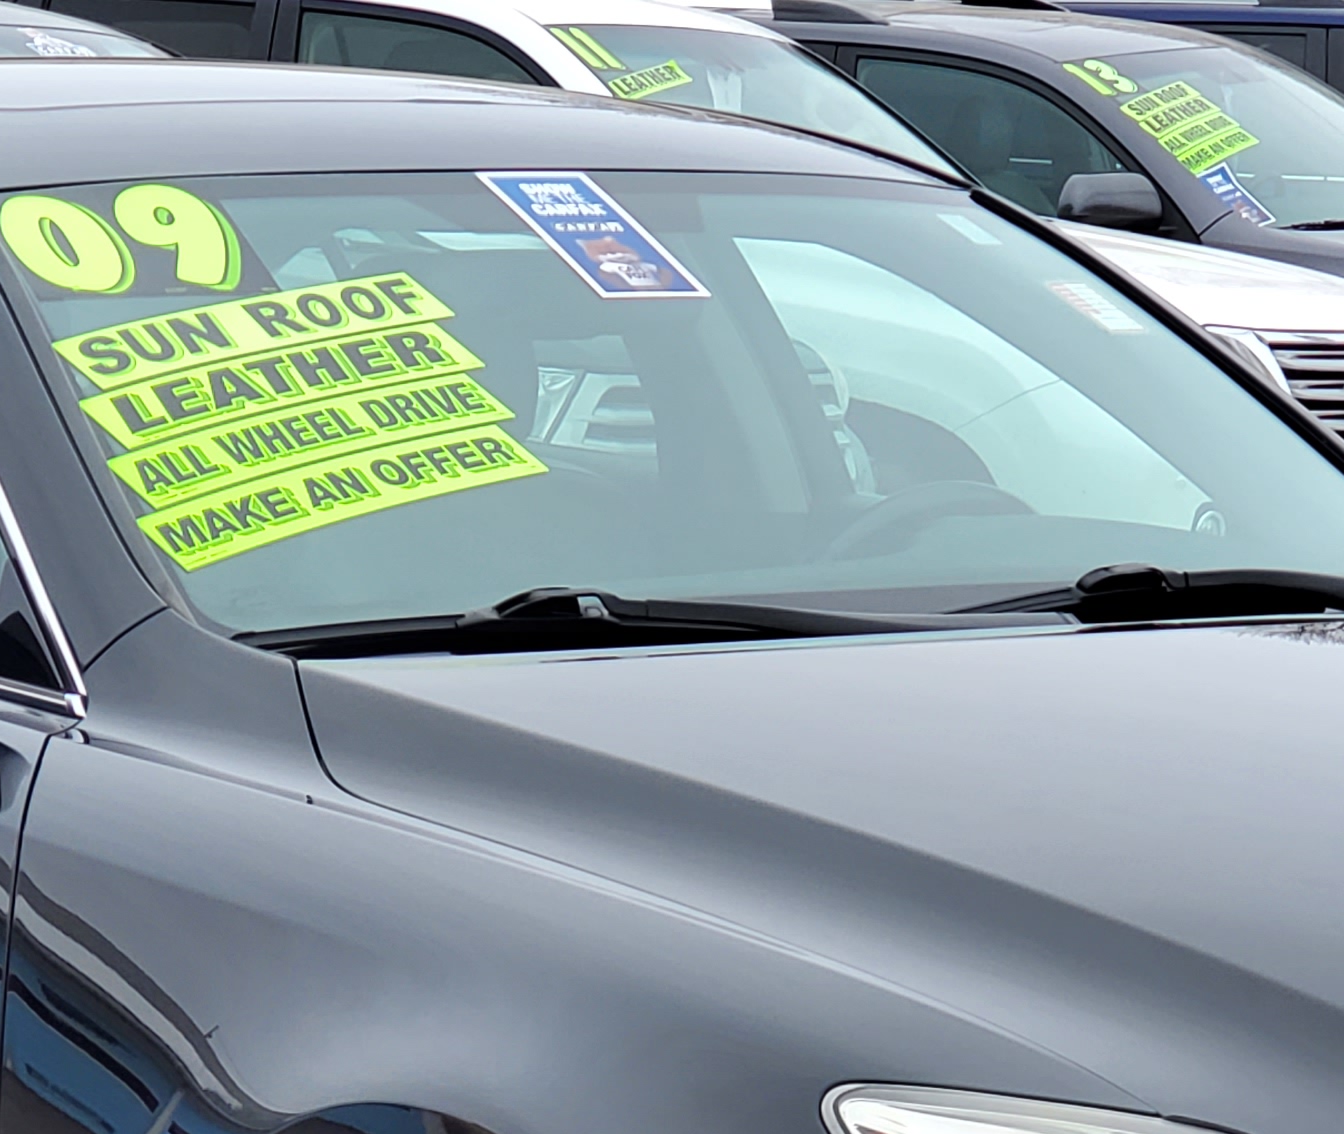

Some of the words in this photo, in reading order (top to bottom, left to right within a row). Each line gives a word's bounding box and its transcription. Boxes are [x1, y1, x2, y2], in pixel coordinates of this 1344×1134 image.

[612, 64, 683, 96] LEATHER
[1063, 59, 1138, 95] 13
[1128, 91, 1160, 117] SUN
[1156, 83, 1191, 106] ROOF
[1144, 98, 1212, 134] LEATHER
[1164, 133, 1190, 155] ALL
[1180, 146, 1216, 173] MAKE
[0, 183, 241, 293] 09
[78, 311, 233, 377] SUN
[242, 277, 426, 339] ROOF
[108, 329, 459, 438] LEATHER
[133, 456, 226, 500] ALL
[216, 407, 373, 466] WHEEL
[366, 381, 491, 430] DRIVE
[156, 486, 309, 555] MAKE
[304, 466, 376, 510] AN
[368, 434, 524, 488] OFFER
